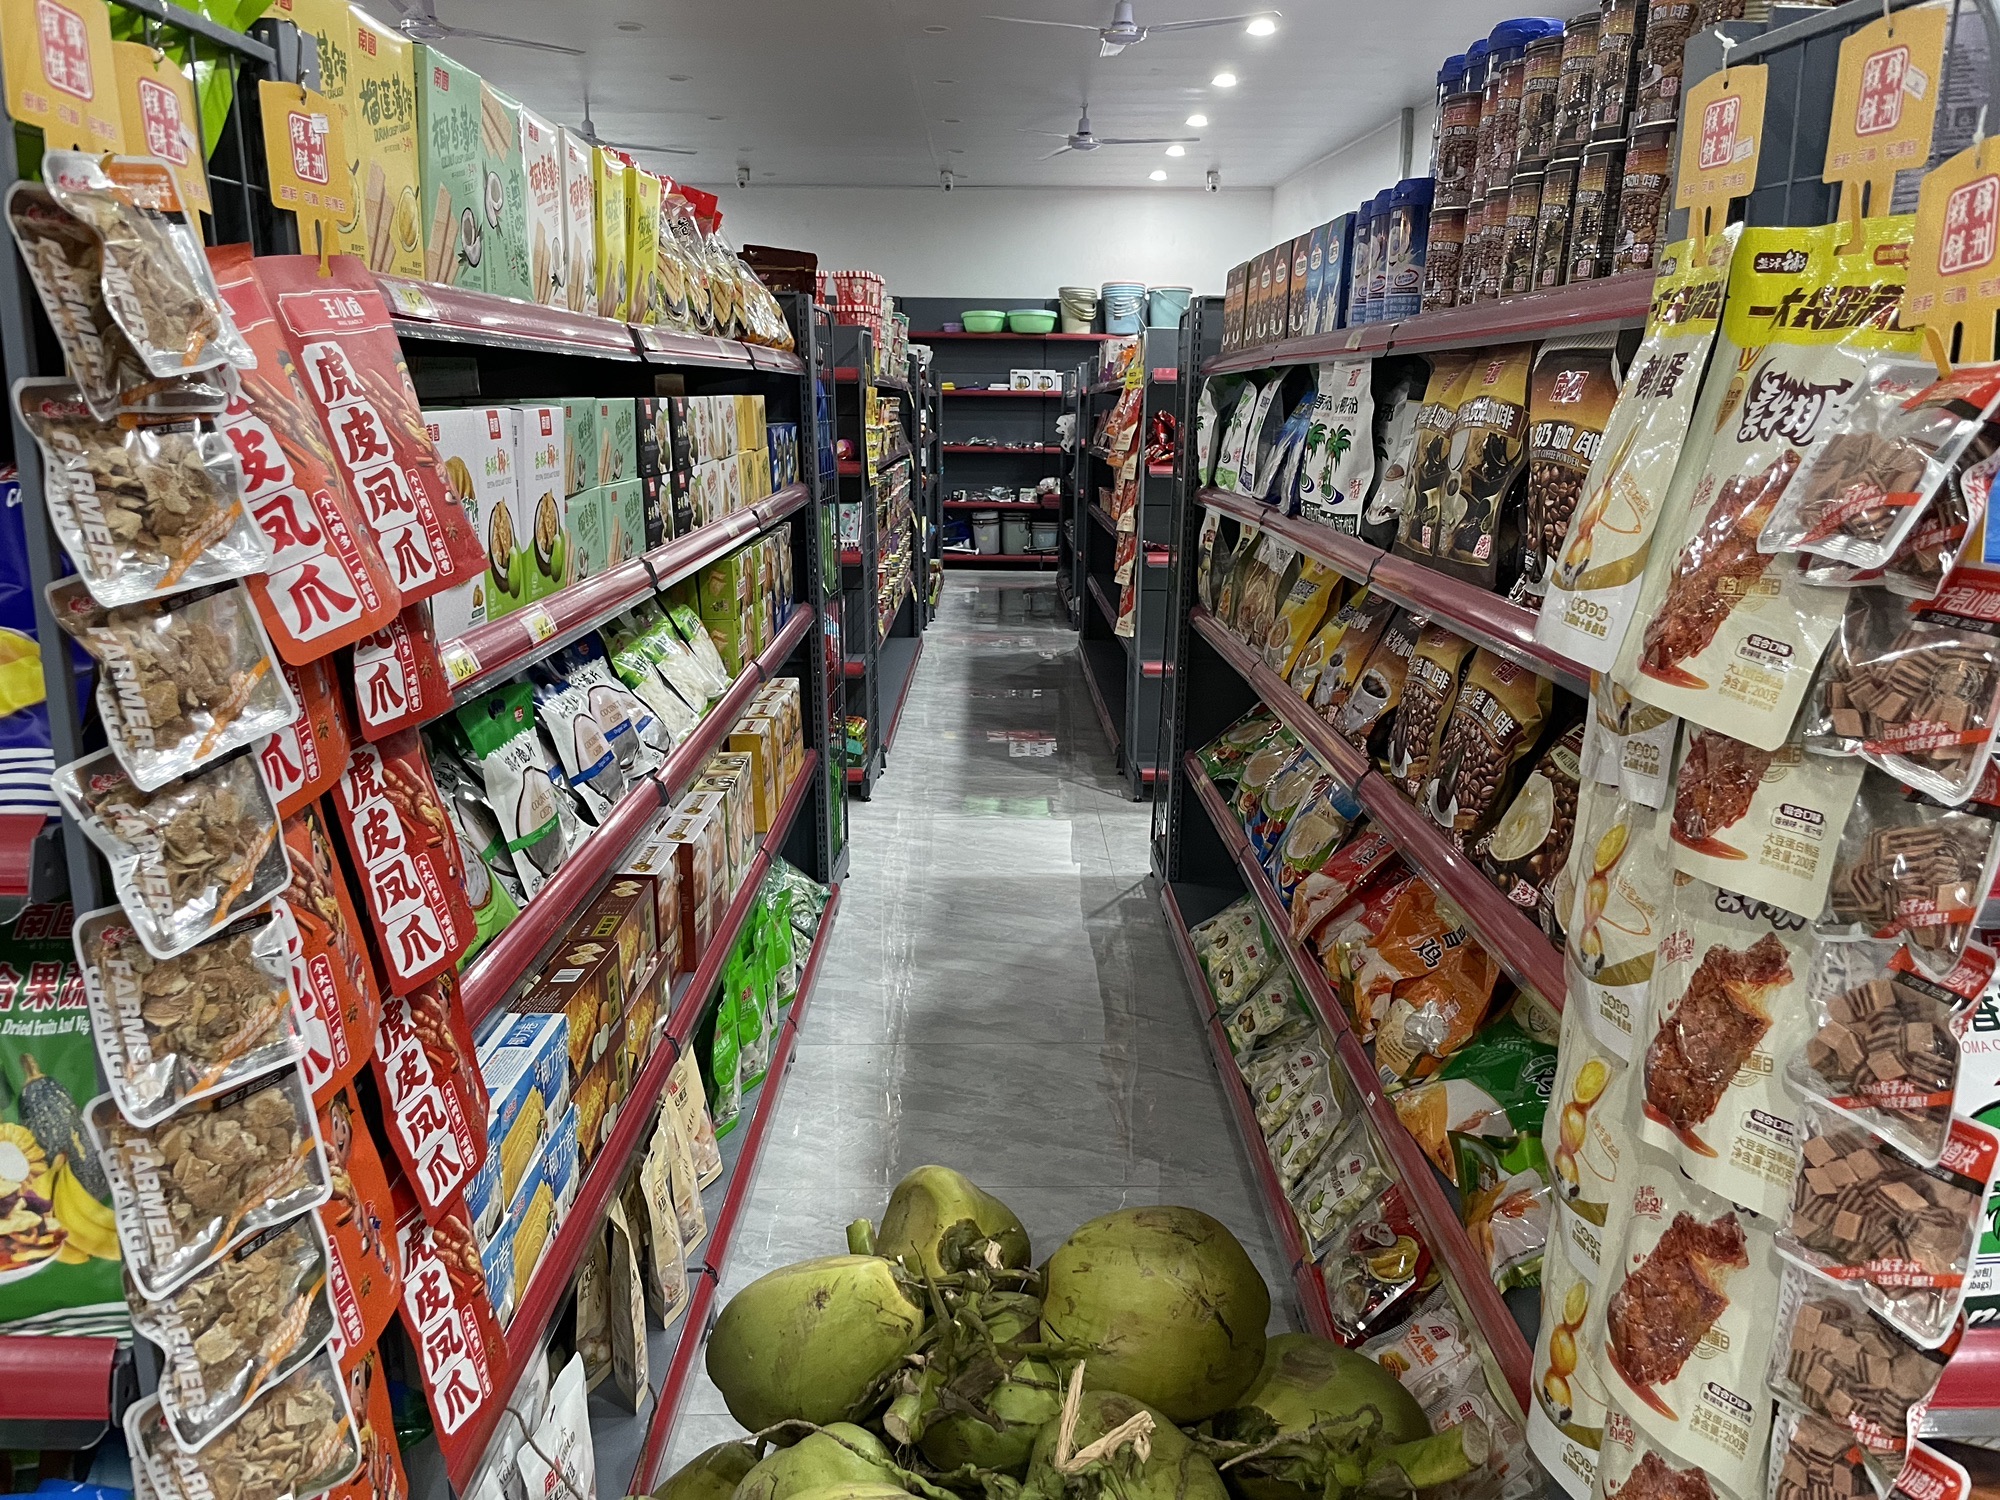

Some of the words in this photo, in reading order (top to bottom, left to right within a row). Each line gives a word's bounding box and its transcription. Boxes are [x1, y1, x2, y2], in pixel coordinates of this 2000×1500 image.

[323, 299, 366, 319] 王小卤
[315, 345, 433, 586] 虎皮凤爪
[224, 367, 356, 634] 皮凤爪
[410, 472, 434, 522] 个大肉多
[319, 496, 352, 549] 个大肉多
[1750, 635, 1790, 656] 混合口味
[1459, 684, 1515, 737] 炭烧咖啡
[1784, 805, 1821, 823] 混合口味
[347, 751, 442, 973] 虎皮凤爪
[1762, 844, 1817, 873] 净含量:200克
[1765, 832, 1820, 859] 大豆蛋白制品
[379, 997, 461, 1204] 虎皮凤爪
[1731, 1146, 1793, 1182] 净含量:200克
[1735, 1136, 1796, 1169] 大豆蛋白制品
[401, 1220, 479, 1430] 虎皮凤爪
[1710, 1384, 1750, 1411] 混合口味
[1690, 1413, 1747, 1456] 净含量:200克
[1694, 1404, 1749, 1443] 大豆蛋白制品
